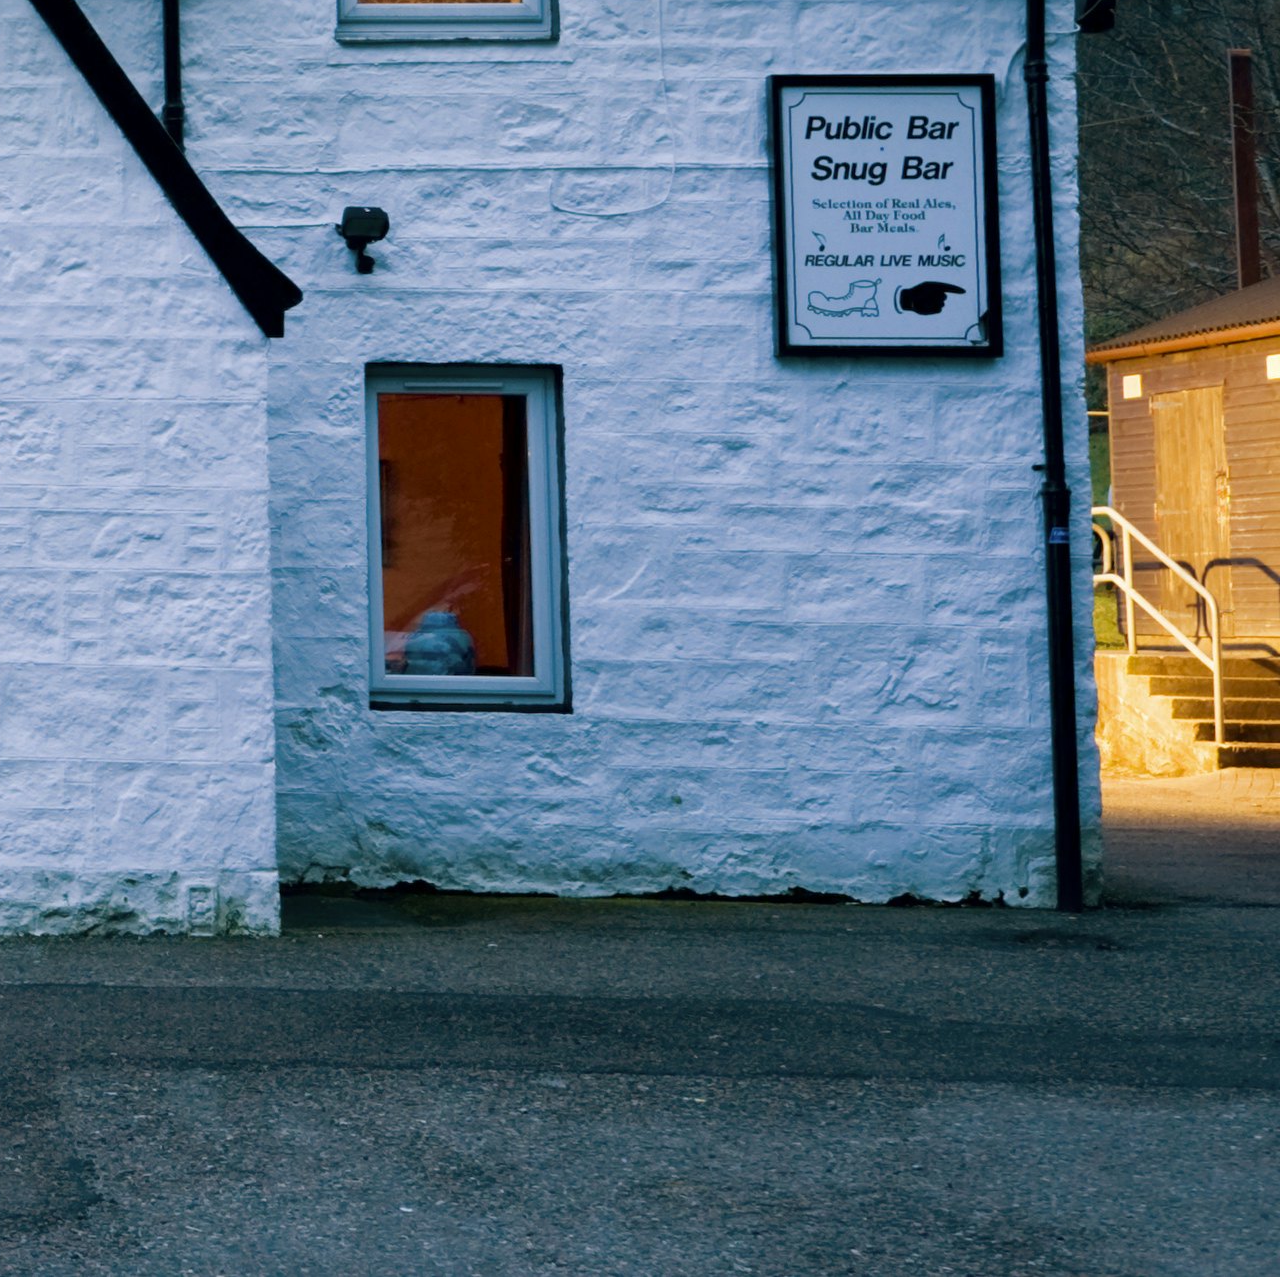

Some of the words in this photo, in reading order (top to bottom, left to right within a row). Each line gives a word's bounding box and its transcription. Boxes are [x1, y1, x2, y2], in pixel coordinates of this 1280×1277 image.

[805, 116, 893, 140] Public
[907, 116, 959, 139] Bar
[811, 156, 887, 186] Snug
[901, 156, 954, 180] Bar
[812, 198, 872, 209] Selection
[876, 199, 889, 208] of
[892, 199, 920, 209] Real
[922, 199, 956, 211] Ales,
[843, 210, 861, 220] All
[866, 210, 890, 223] Day
[894, 210, 926, 220] Food
[850, 223, 874, 233] Bar
[805, 255, 874, 267] REGULAR
[880, 255, 912, 266] LIVE
[917, 255, 966, 267] MUSIC
